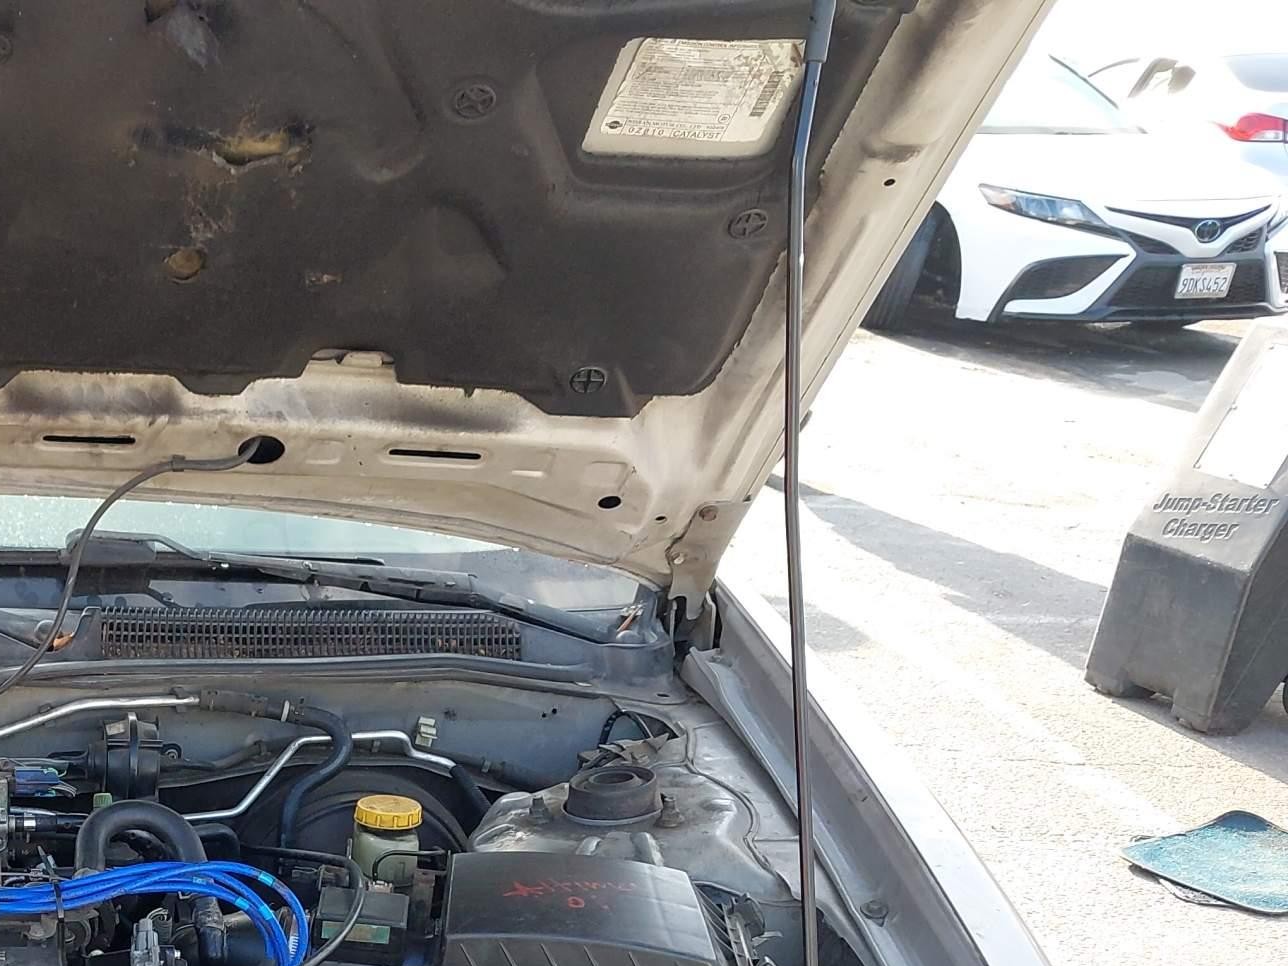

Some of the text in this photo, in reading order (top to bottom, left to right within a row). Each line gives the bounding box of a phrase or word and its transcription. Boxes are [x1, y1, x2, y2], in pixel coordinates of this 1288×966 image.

[672, 130, 722, 139] CATALYST
[1179, 276, 1227, 293] 9DKS452
[1153, 493, 1279, 516] Jump-Starter
[1162, 518, 1240, 542] Charger
